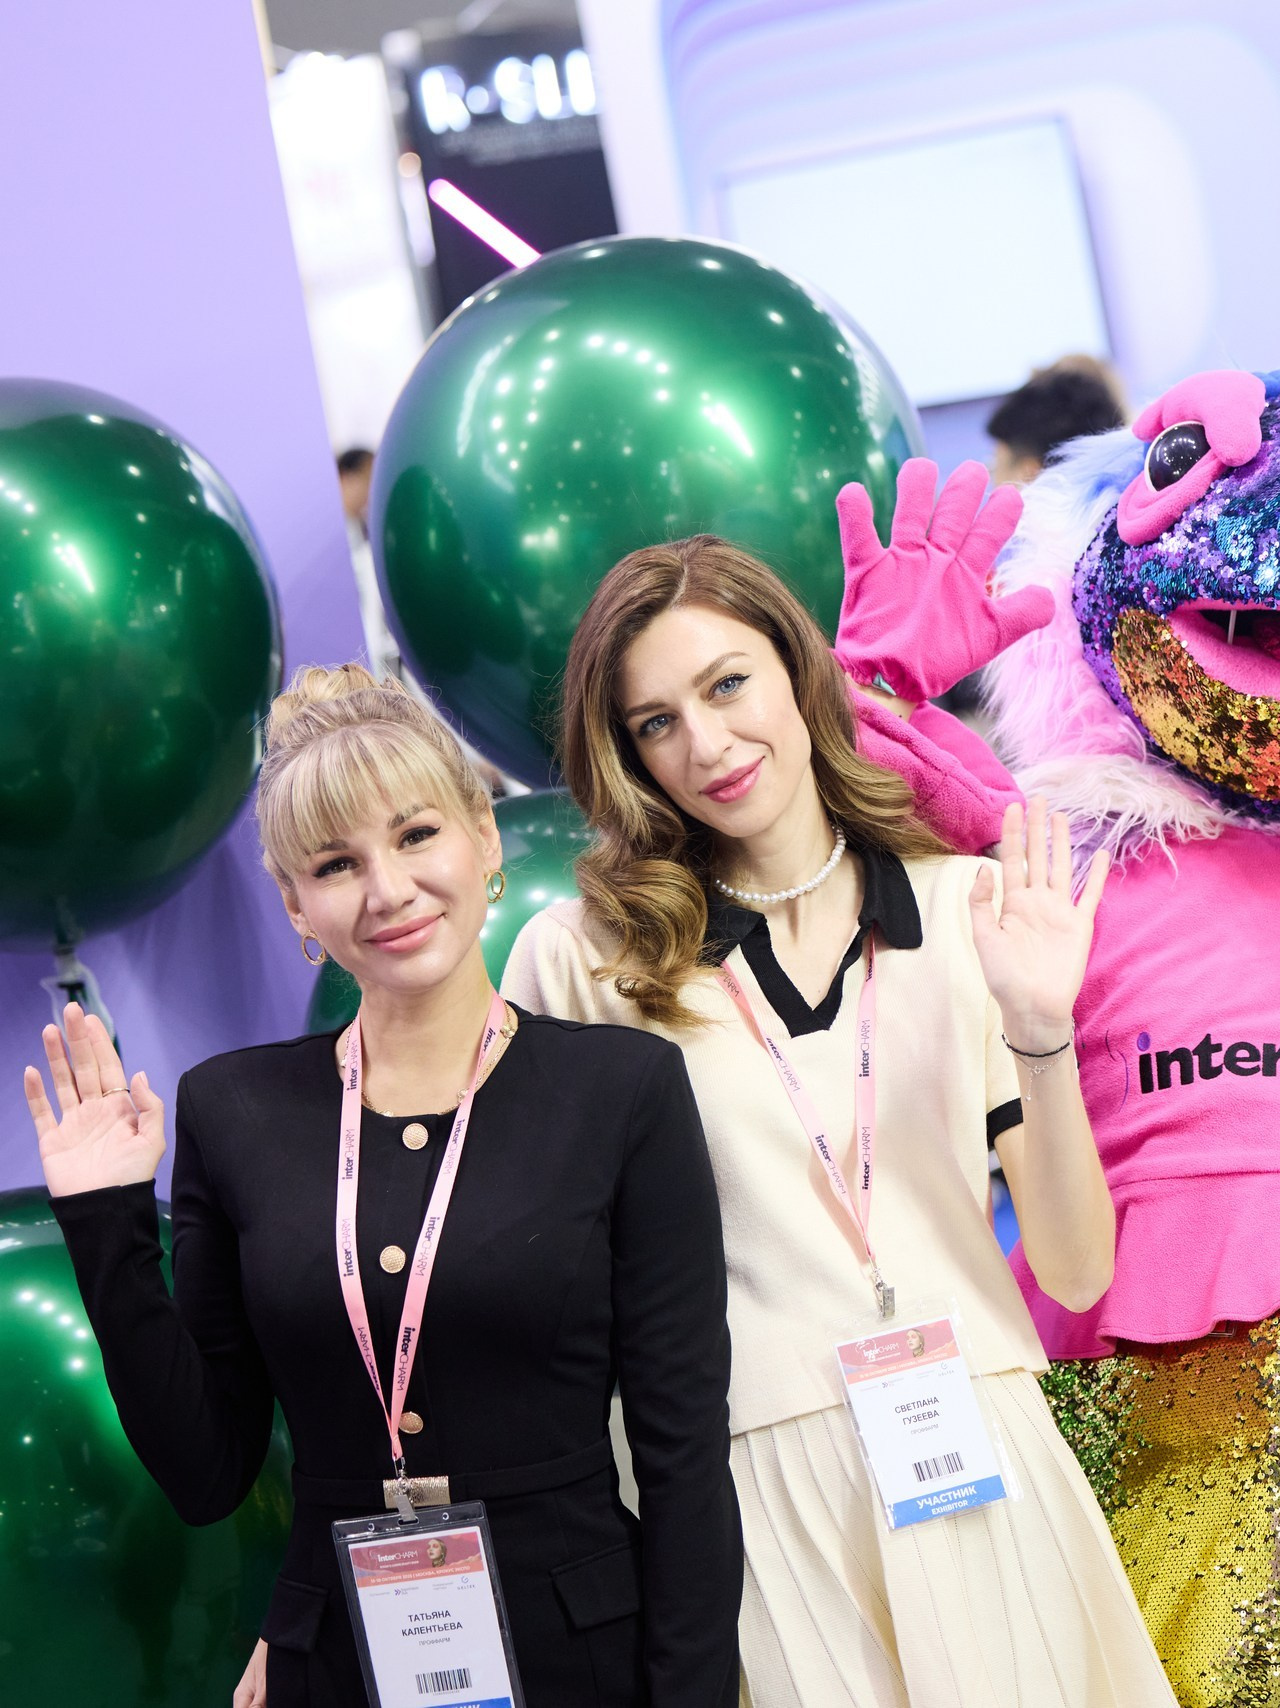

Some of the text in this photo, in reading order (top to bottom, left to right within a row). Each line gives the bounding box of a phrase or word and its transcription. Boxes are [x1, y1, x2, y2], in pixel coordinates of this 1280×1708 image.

[346, 1040, 358, 1092] interCHARM
[859, 1019, 871, 1078] interCHARM
[342, 1128, 356, 1181] interCHARM
[443, 1119, 466, 1176] interCHARM
[815, 1134, 847, 1195] interCHARM
[861, 1126, 871, 1191] interCHARM
[342, 1218, 355, 1278] interCHARM
[415, 1216, 441, 1277] interCHARM
[397, 1326, 416, 1392] interCHARM
[894, 1396, 940, 1414] СВЕТЛАНА
[902, 1410, 940, 1426] ГУЗЕЕВА
[916, 1484, 977, 1509] УЧАСТНИК
[931, 1500, 969, 1516] EXHIBITOR
[401, 1621, 464, 1637] КАЛЕНТЬЕВА
[407, 1609, 452, 1623] ТАТЬЯНА
